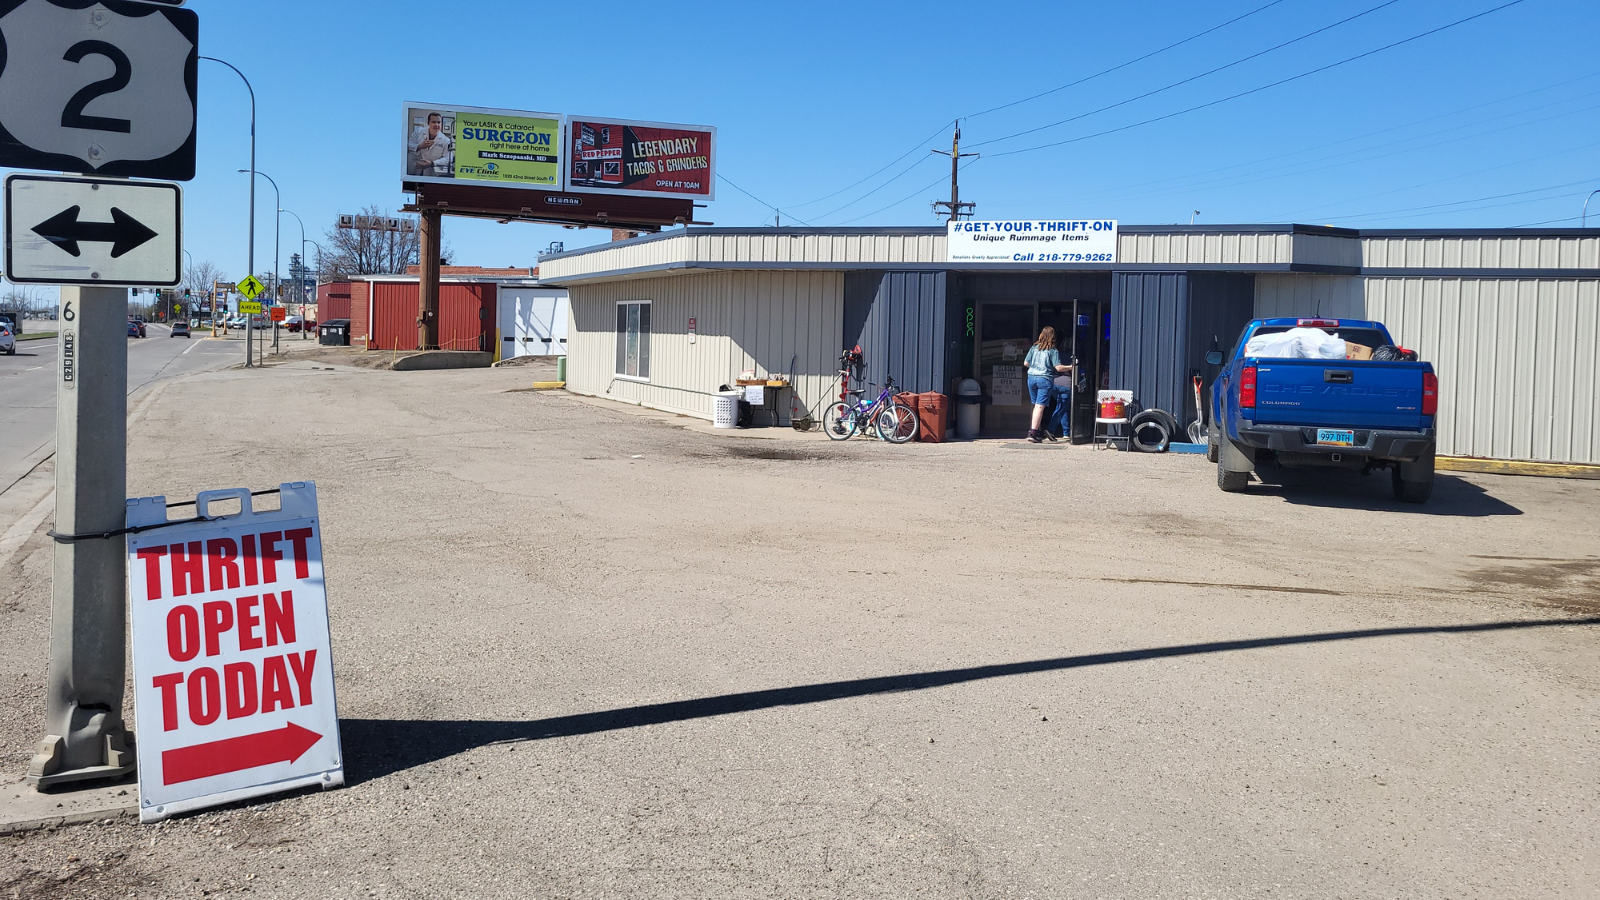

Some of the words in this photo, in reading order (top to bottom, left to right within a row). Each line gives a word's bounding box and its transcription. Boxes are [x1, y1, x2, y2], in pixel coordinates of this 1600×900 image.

[61, 40, 132, 133] 2
[479, 121, 497, 129] LASIK
[505, 123, 535, 131] Cataract
[462, 127, 551, 146] SURGEON
[489, 142, 505, 150] right
[530, 144, 550, 152] home
[582, 150, 596, 158] RED
[596, 149, 621, 157] PEPPER
[631, 137, 698, 159] LEGENDARY
[626, 161, 656, 176] TACOS
[657, 160, 665, 173] &
[666, 155, 708, 172] GRINDERS
[655, 179, 673, 187] OPEN
[674, 180, 683, 188] AT
[683, 181, 700, 189] 10AM
[547, 197, 579, 205] NEWMAN
[973, 234, 1005, 242] Unique
[1009, 234, 1057, 242] Rummage
[1061, 233, 1089, 241] Items
[1013, 253, 1034, 261] Call
[1038, 253, 1112, 261] 218-779-9262
[63, 300, 75, 322] 6
[1264, 384, 1415, 397] CHEVROLET
[1320, 433, 1335, 441] 997
[136, 527, 313, 601] THRIFT
[166, 590, 297, 662] OPEN
[152, 649, 318, 732] TODAY
